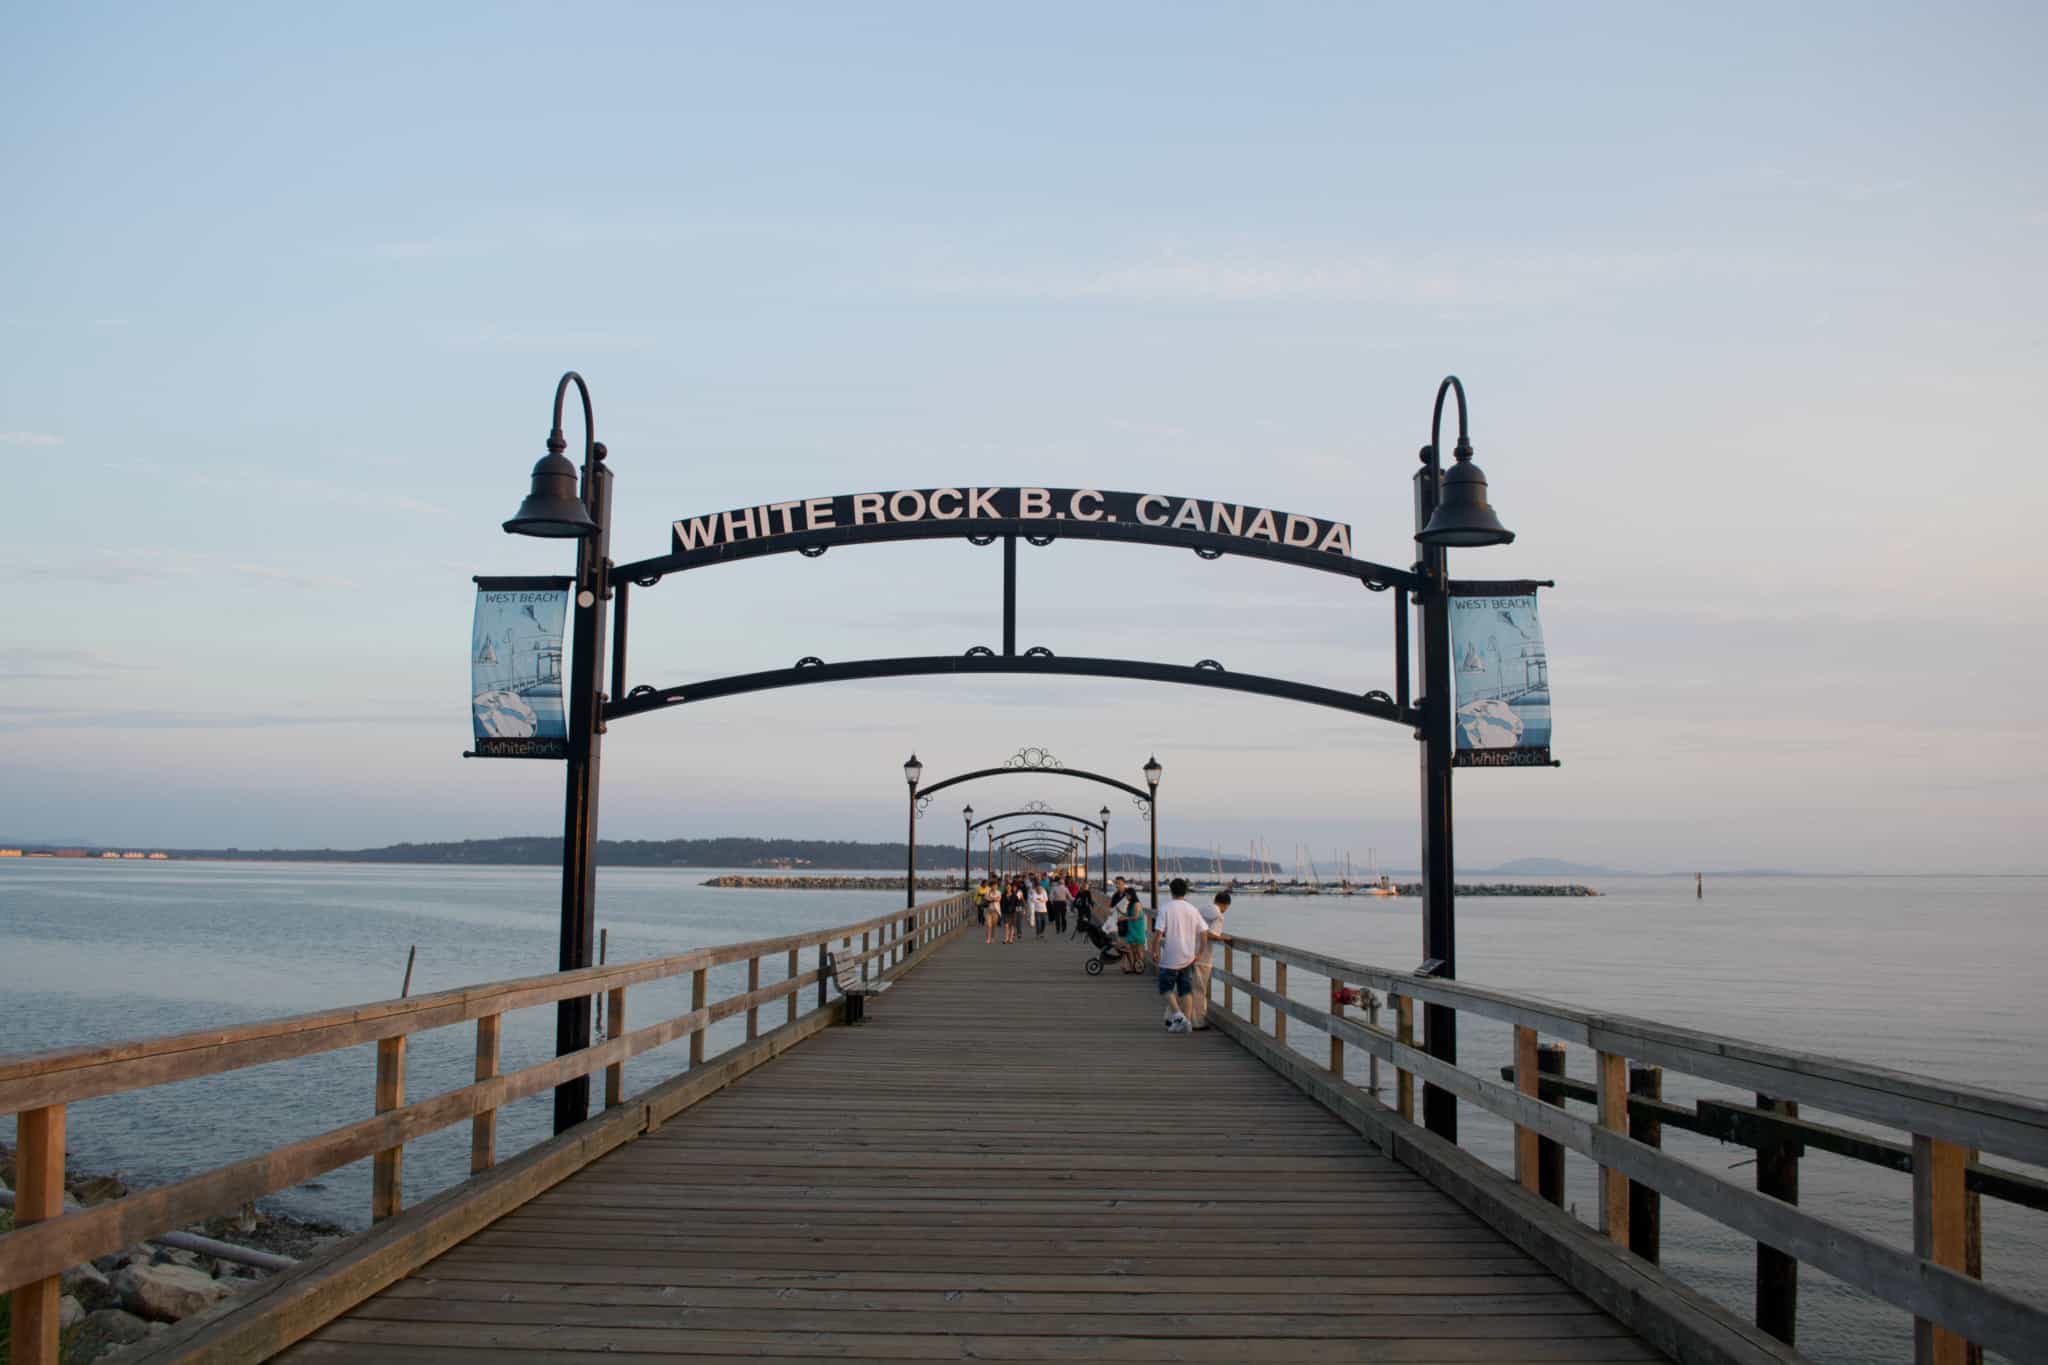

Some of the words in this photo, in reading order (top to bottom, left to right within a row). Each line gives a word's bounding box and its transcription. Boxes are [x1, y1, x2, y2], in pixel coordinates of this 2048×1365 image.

[673, 497, 836, 551] WHITE
[853, 487, 1002, 526] ROCK
[1019, 487, 1117, 523] B.C.
[1135, 494, 1351, 557] CANADA
[485, 592, 517, 603] WEST
[519, 592, 559, 603] BEACH
[1455, 599, 1488, 610] WEST
[1491, 598, 1531, 610] BEACH
